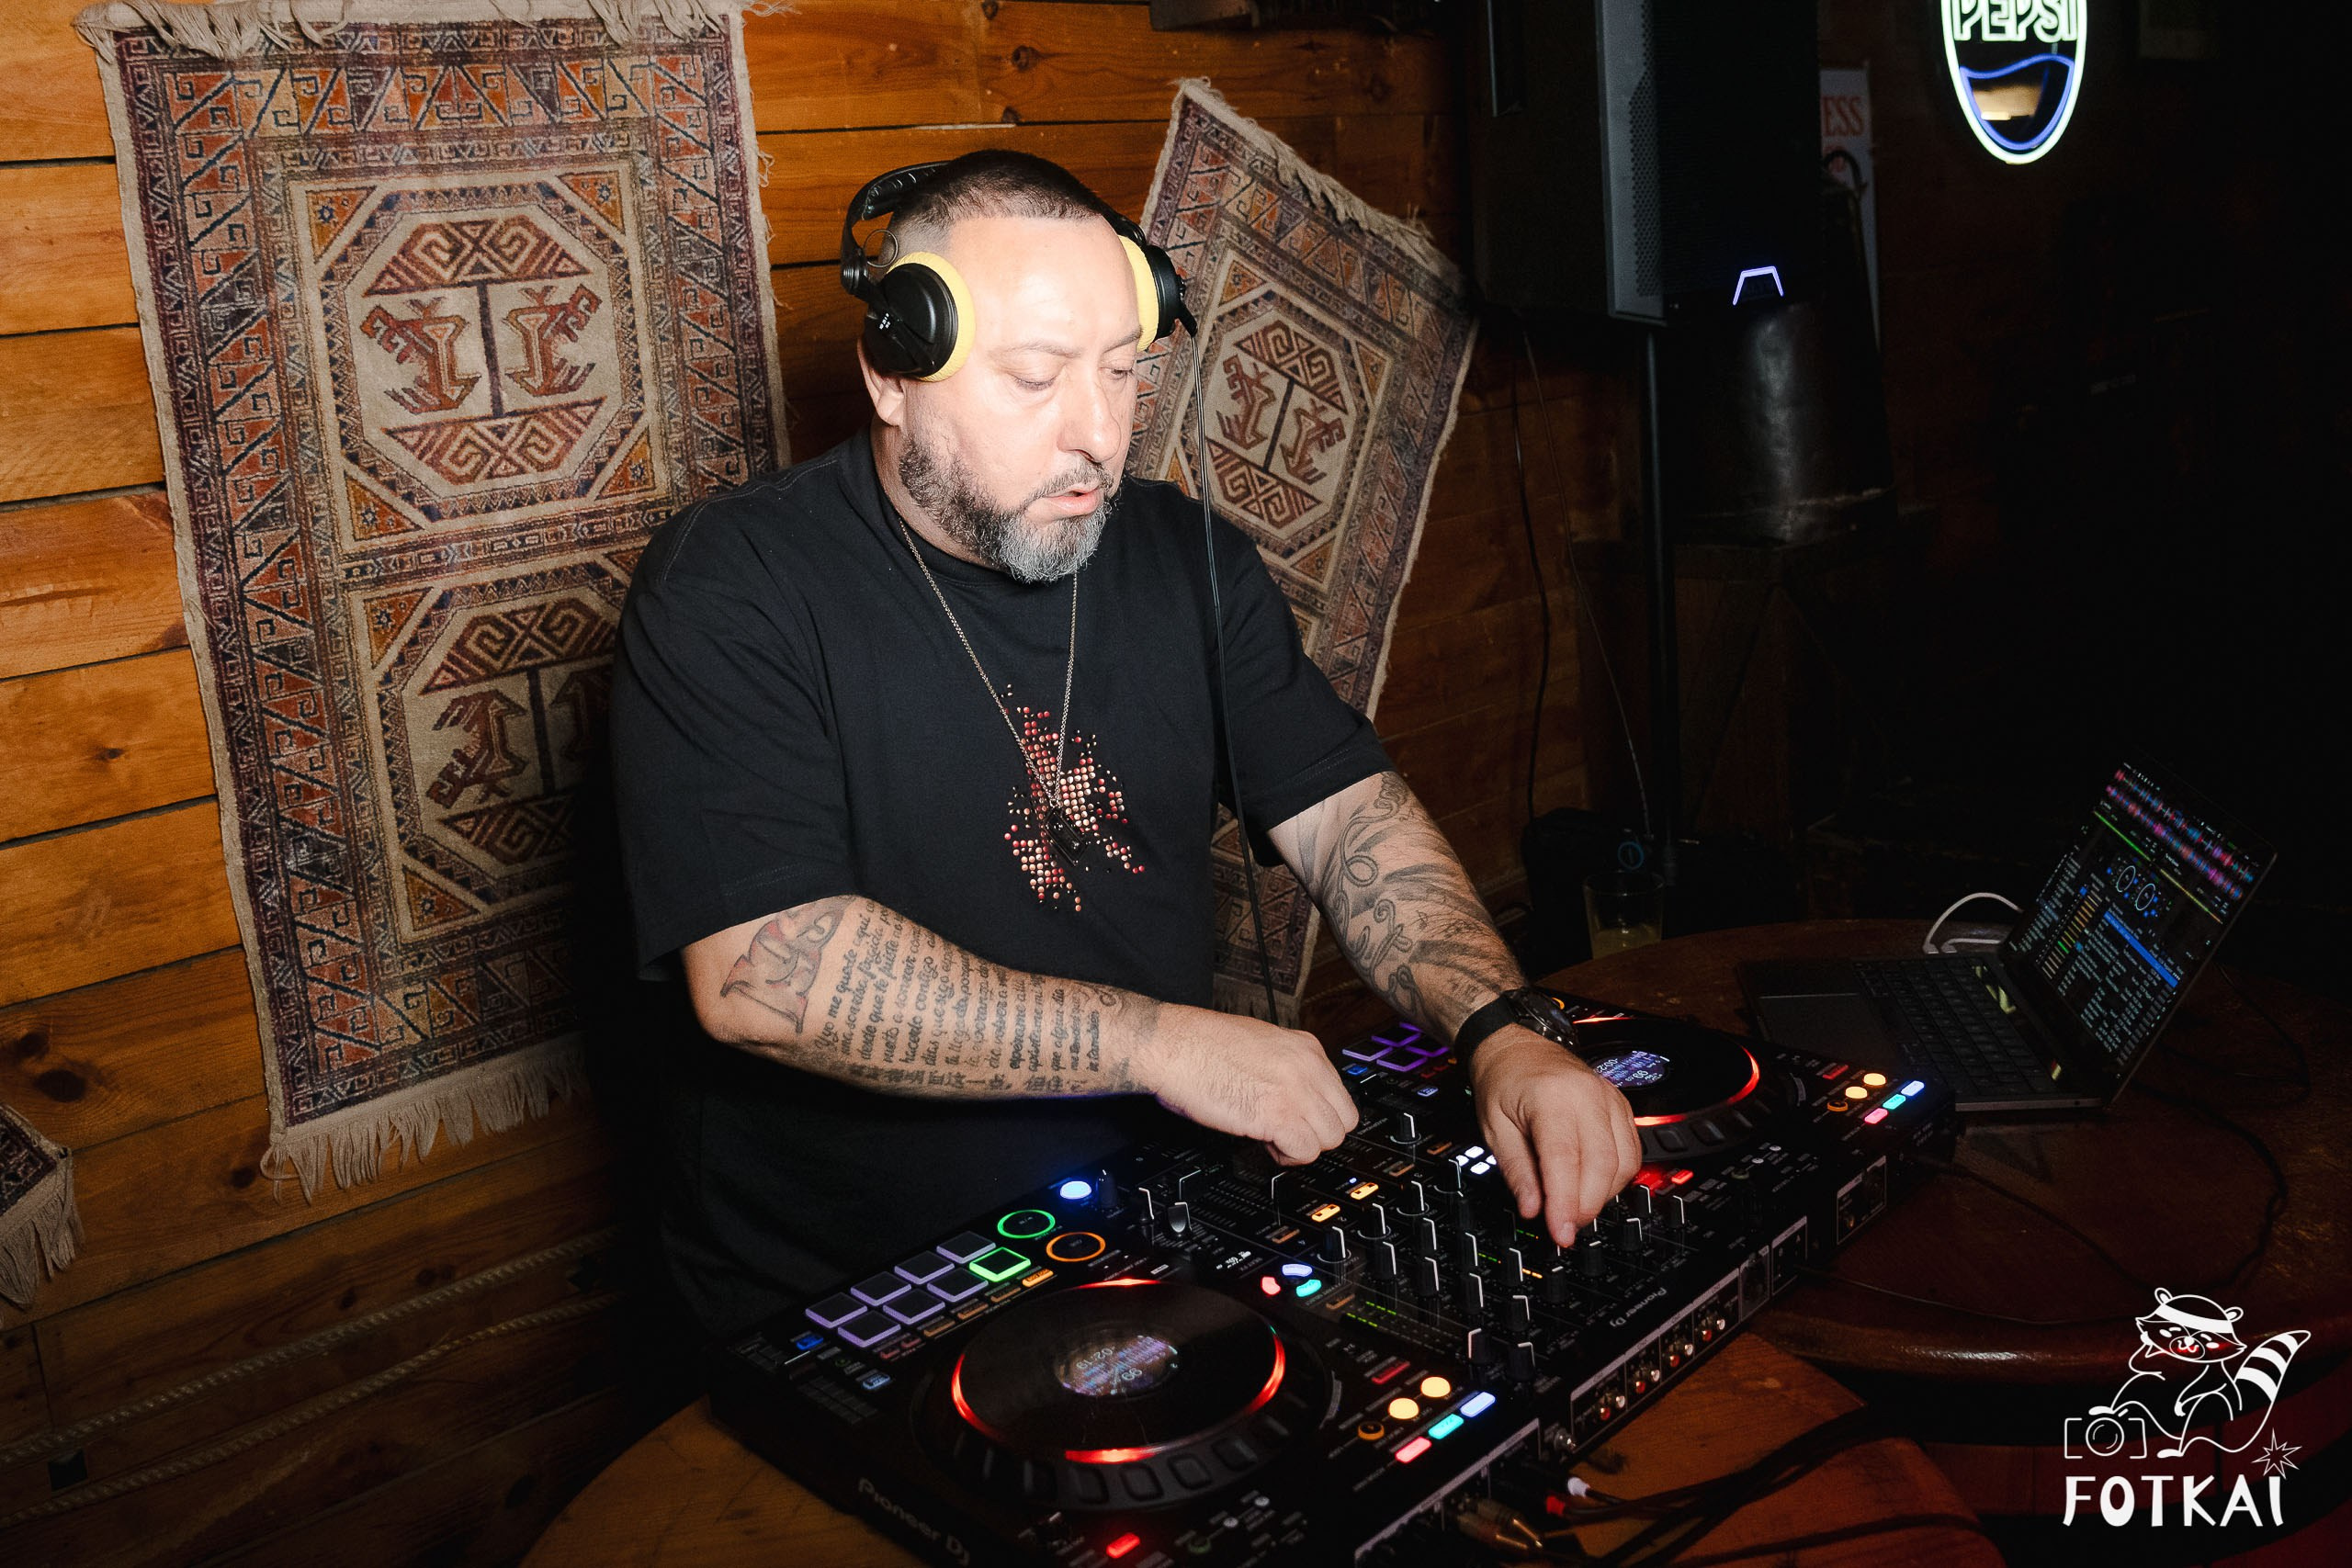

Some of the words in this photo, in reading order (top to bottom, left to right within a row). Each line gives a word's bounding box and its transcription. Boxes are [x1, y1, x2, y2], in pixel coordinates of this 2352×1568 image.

[1953, 0, 2077, 42] PEPSI
[879, 939, 899, 979] fuiste
[874, 977, 888, 994] te
[827, 996, 842, 1019] me
[868, 994, 884, 1024] que
[899, 1014, 922, 1065] hacerlo
[914, 955, 935, 1011] contigo
[857, 1024, 876, 1060] desde
[1624, 1287, 1667, 1317] Pioneer
[1609, 1316, 1627, 1328] DJ
[858, 1476, 942, 1541] Pioneer
[944, 1535, 971, 1567] DJ
